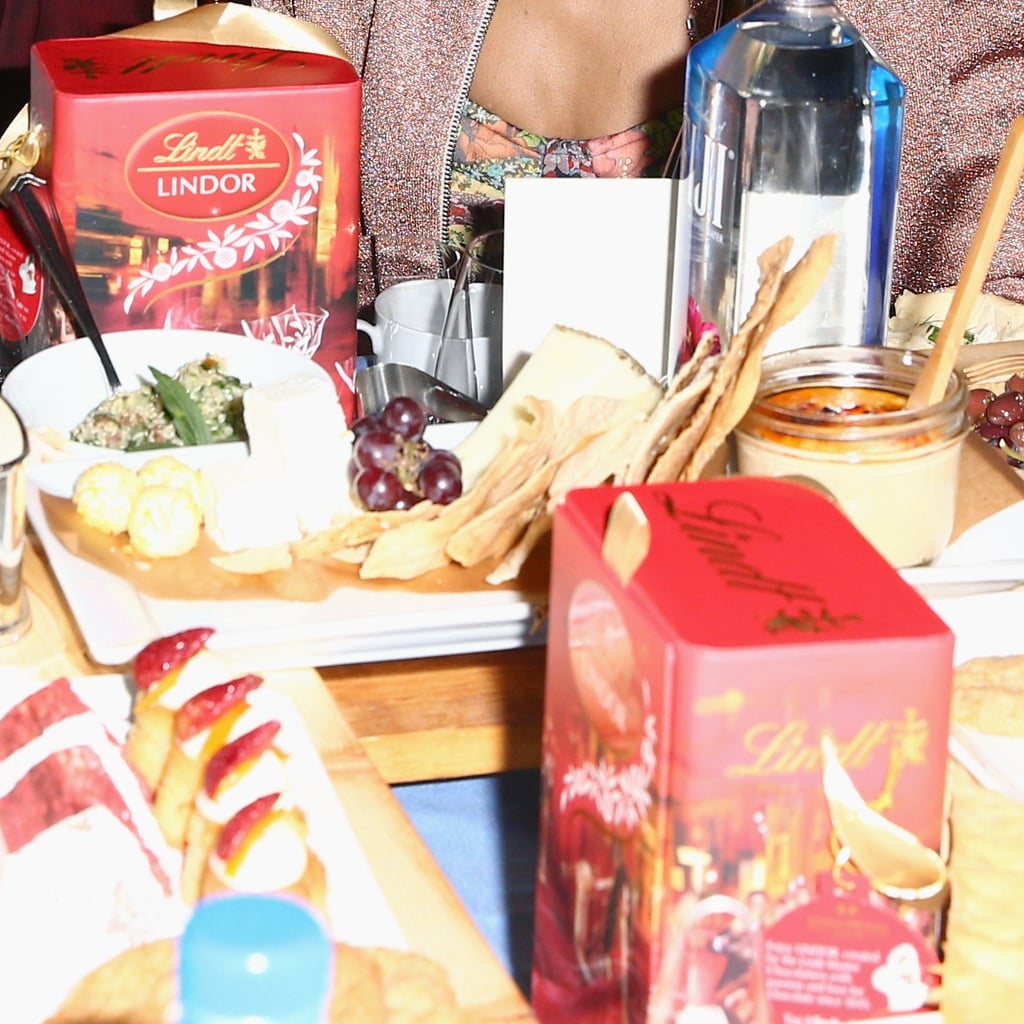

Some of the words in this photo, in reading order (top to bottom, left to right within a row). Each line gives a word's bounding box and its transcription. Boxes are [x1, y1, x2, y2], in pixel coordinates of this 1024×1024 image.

[153, 132, 245, 164] Lindt
[157, 173, 257, 198] LINDOR
[652, 490, 825, 603] Lindt
